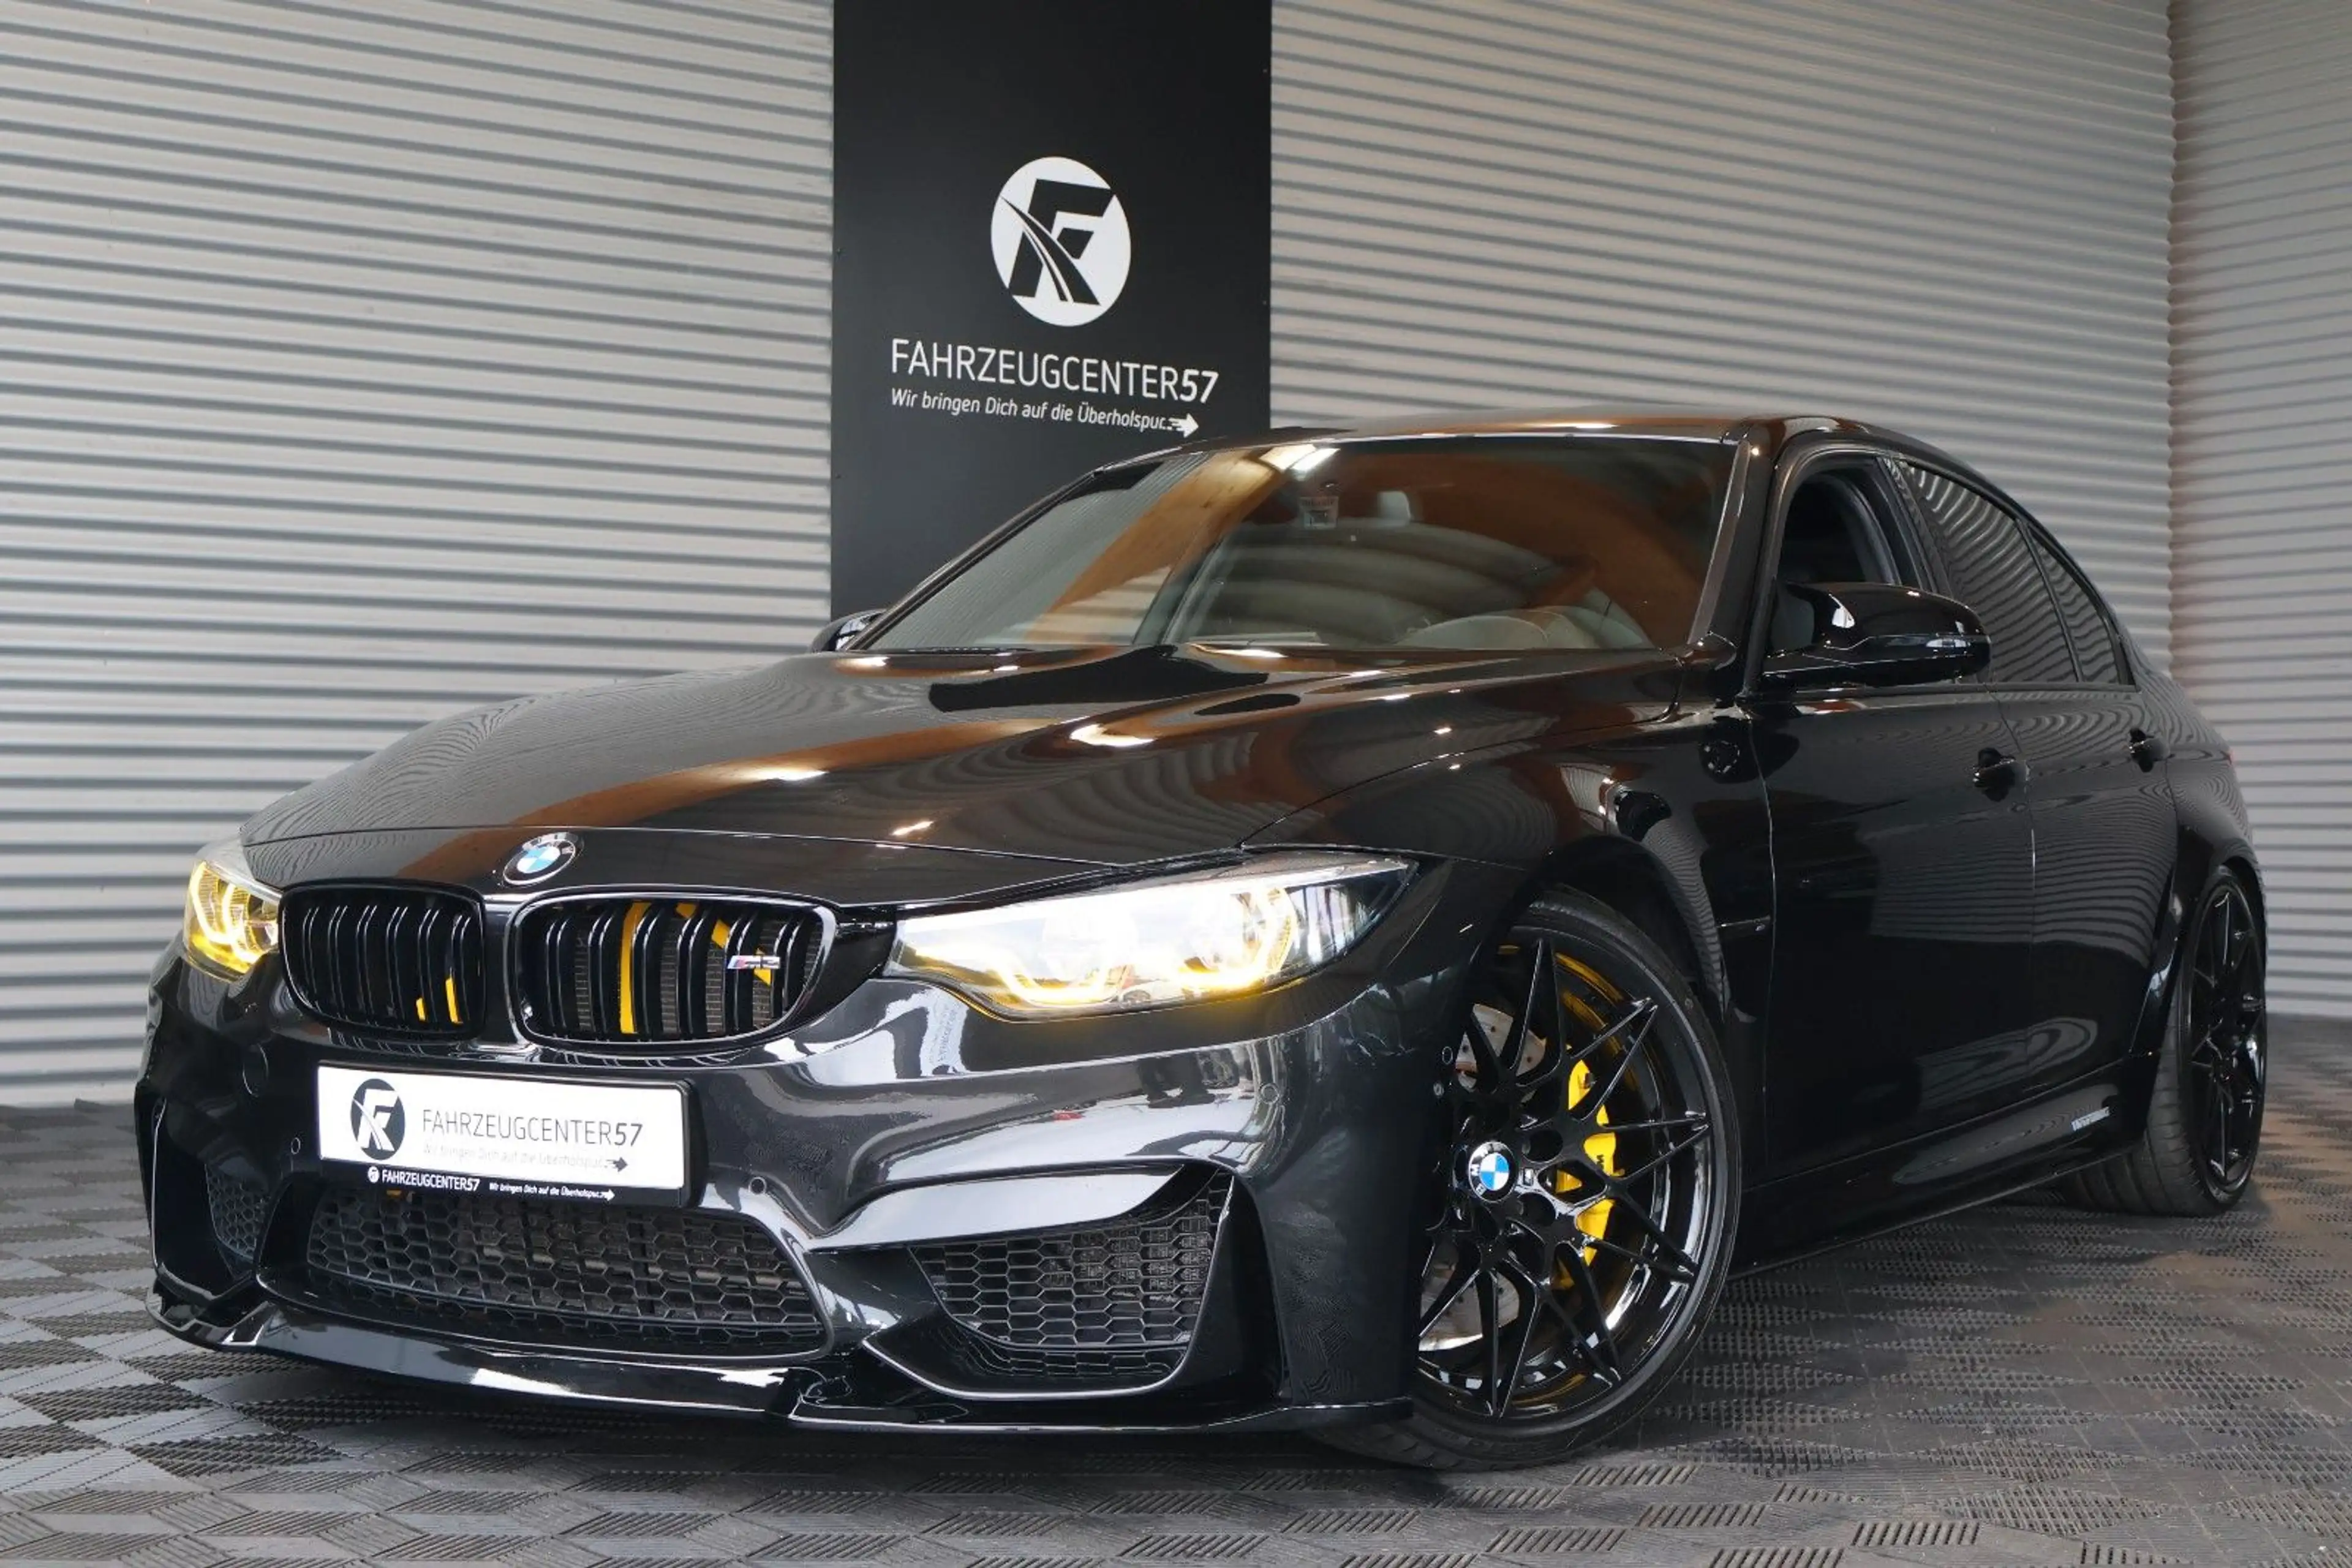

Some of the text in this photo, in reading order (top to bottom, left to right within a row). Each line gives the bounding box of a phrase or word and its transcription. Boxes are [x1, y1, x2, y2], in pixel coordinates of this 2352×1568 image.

[892, 338, 1219, 403] FAHRZEUGCENTER57
[892, 388, 918, 407] Wir
[922, 391, 980, 416] bringen
[984, 396, 1018, 417] Dich
[1021, 402, 1049, 420] auf
[1050, 403, 1073, 421] die
[423, 1109, 643, 1147] FAHRZEUGCENTER57
[382, 1169, 480, 1191] FAHRZEUGCENTER57
